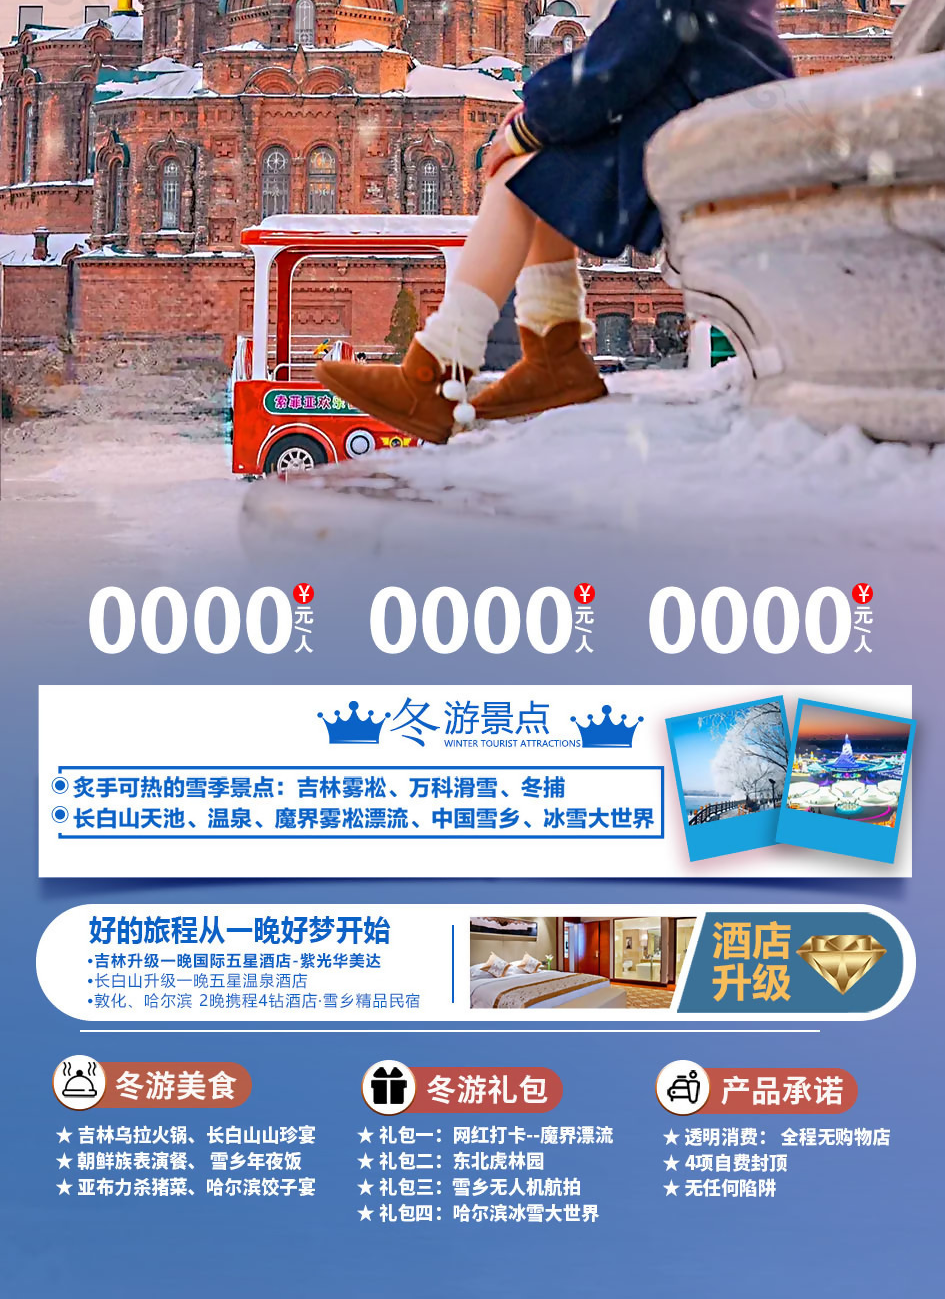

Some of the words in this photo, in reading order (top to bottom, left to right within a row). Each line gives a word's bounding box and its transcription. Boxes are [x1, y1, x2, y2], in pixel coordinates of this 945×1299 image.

[88, 585, 293, 655] 0000
[369, 585, 573, 655] 0000
[648, 585, 852, 655] 0000
[390, 697, 550, 748] 冬游景点
[443, 739, 479, 748] WINTER
[480, 739, 518, 748] TOURIST
[520, 739, 581, 748] ATTRACTIONS
[73, 775, 566, 799] 炙手可热的雪季景点：吉林雾凇、万科滑雪、冬捕
[72, 806, 655, 830] 长白山天池、温泉、魔界雾凇漂流、中国雪乡、冰雪大世界
[88, 915, 391, 945] 好的旅程从一晚好梦开始
[713, 920, 791, 960] 酒店
[94, 952, 381, 969] 吉林升级一晚国际五星酒店-紫光华美达
[94, 972, 308, 989] 长白山升级一晚五星温泉酒店
[712, 962, 791, 1002] 升级
[115, 1070, 237, 1101] 冬游美食
[427, 1074, 548, 1105] 冬游礼包
[721, 1075, 843, 1106] 产品承诺
[78, 1124, 316, 1145] 吉林乌拉火锅、长白山山珍宴
[379, 1151, 544, 1171] 礼包二：东北虎林园
[684, 1153, 788, 1173] 4项自费封顶
[77, 1176, 316, 1197] 亚布力杀猪菜、哈尔滨饺子宴
[379, 1177, 581, 1197] 礼包三：雪乡无人机航拍
[684, 1178, 777, 1198] 无任何陷阱
[379, 1203, 600, 1223] 礼包四：哈尔滨冰雪大世界
